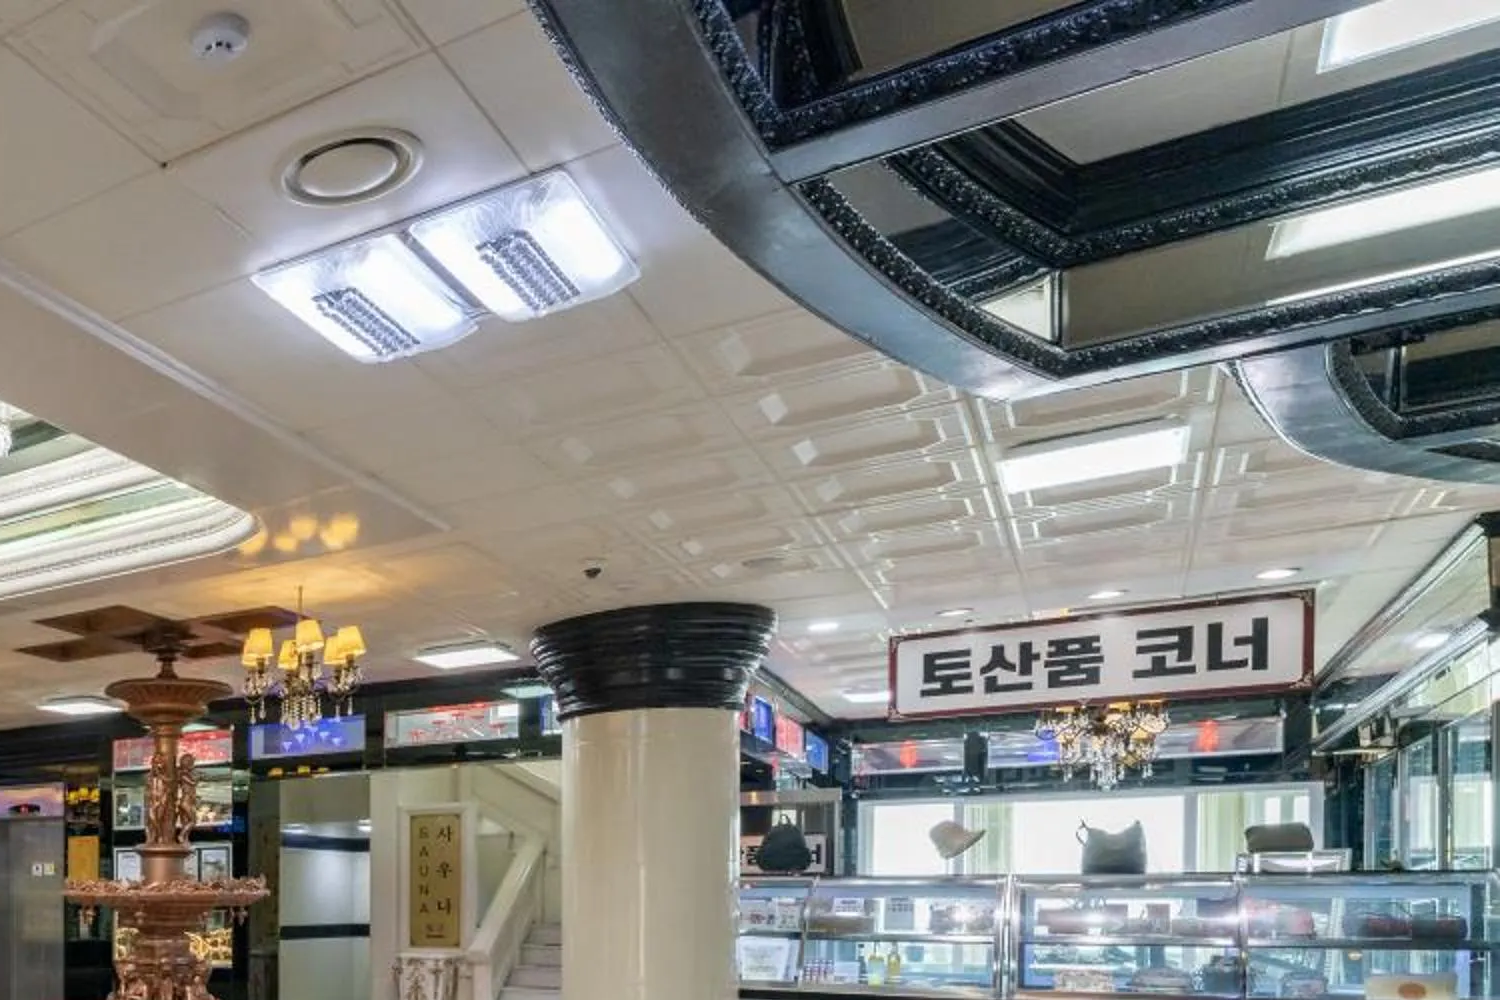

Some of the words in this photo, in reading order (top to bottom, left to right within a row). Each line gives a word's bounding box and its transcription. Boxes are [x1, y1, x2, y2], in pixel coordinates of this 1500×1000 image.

[920, 635, 1104, 697] 토산품
[1132, 617, 1269, 679] 코너
[418, 825, 430, 914] SAUNA
[436, 823, 453, 916] 사우나
